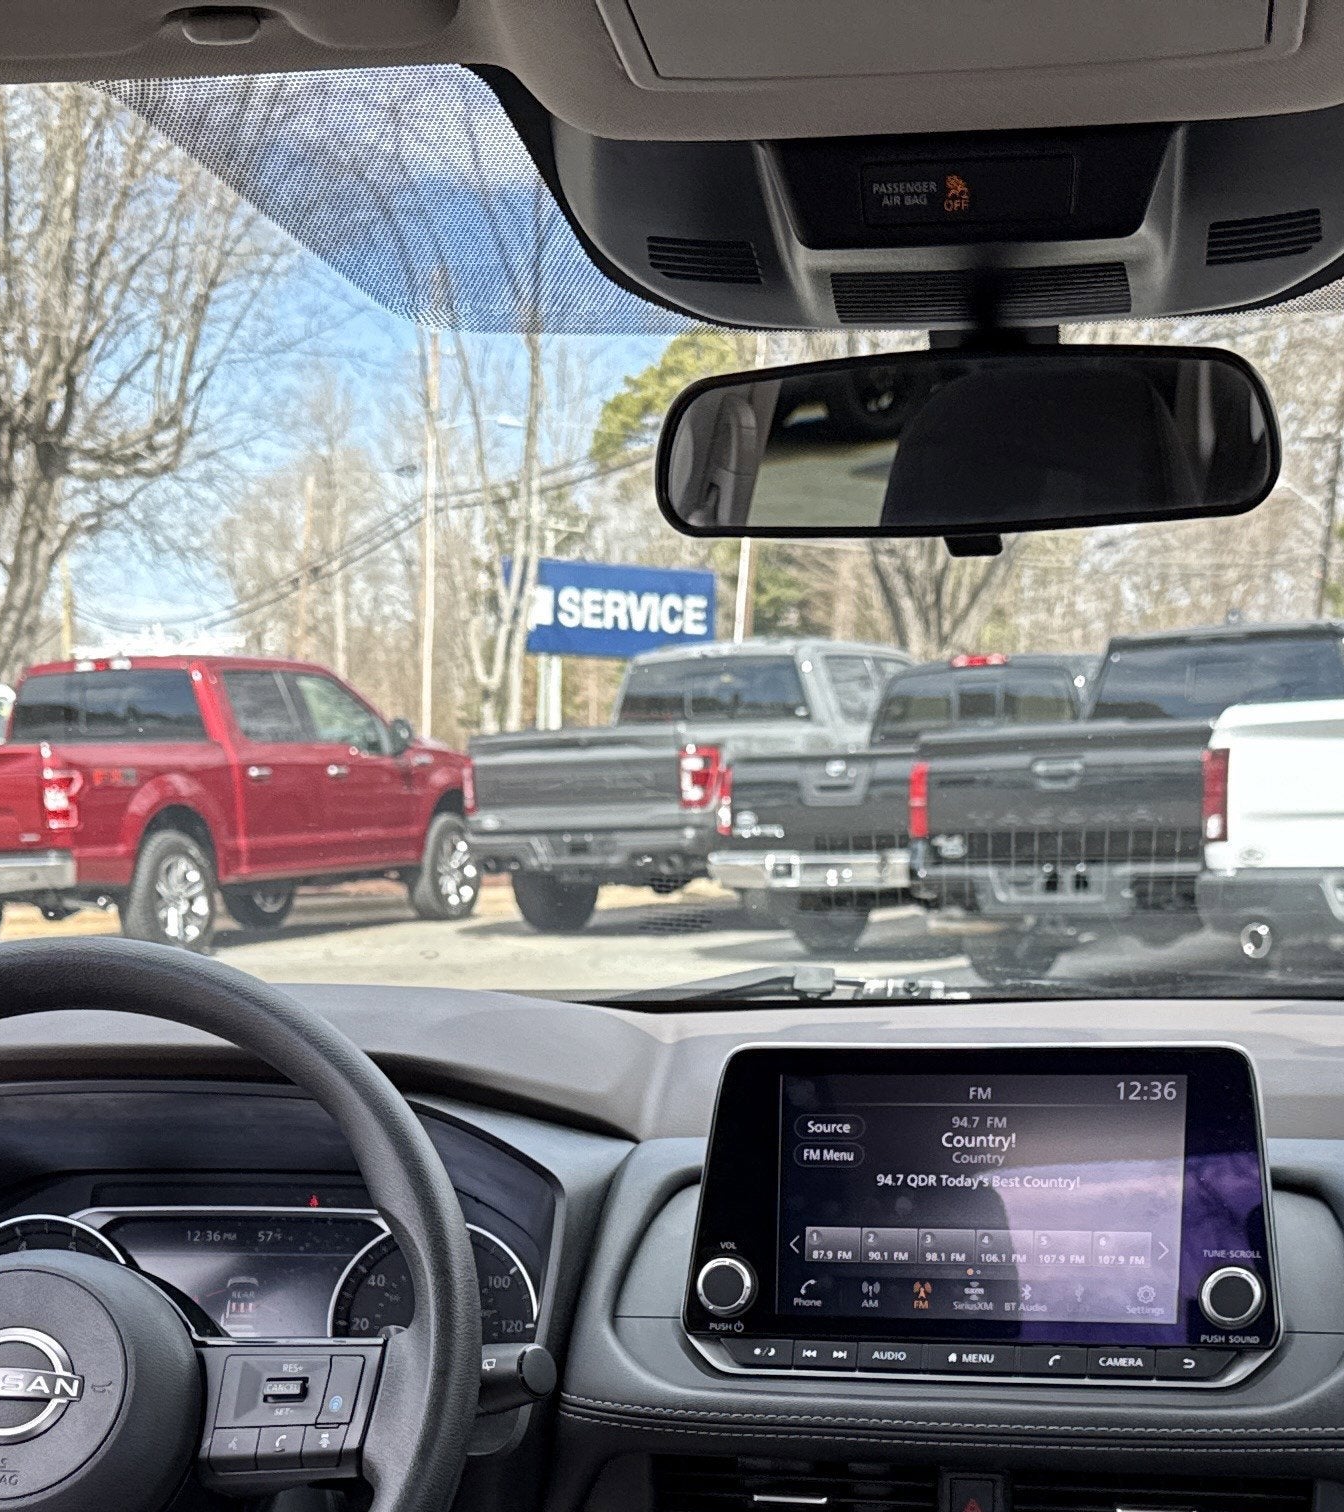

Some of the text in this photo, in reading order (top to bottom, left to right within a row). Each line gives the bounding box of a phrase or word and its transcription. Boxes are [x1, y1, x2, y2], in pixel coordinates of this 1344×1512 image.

[872, 181, 938, 195] PASSENGER
[881, 195, 901, 206] AIR
[943, 200, 970, 212] OFF
[557, 585, 709, 636] SERVICE
[968, 1087, 992, 1100] FM
[1116, 1081, 1178, 1101] 12:36
[807, 1120, 852, 1134] Source
[951, 1116, 1007, 1128] 94.7 FM
[941, 1132, 1017, 1150] Country!
[803, 1149, 855, 1161] FM Menu
[952, 1152, 1005, 1167] Country
[876, 1174, 1081, 1191] 94.7 QDR Today's Best Country!
[719, 1241, 737, 1250] VOL
[812, 1250, 853, 1260] 87.9 FM
[868, 1251, 909, 1261] 90.1 FM
[925, 1252, 966, 1262] 98.1 FM
[980, 1253, 1027, 1263] 106.1 FM
[1069, 1255, 1085, 1264] FM
[1129, 1256, 1145, 1265] FM
[367, 1273, 386, 1287] 40
[488, 1275, 511, 1289] 100
[793, 1297, 822, 1307] Phone
[861, 1299, 879, 1308] AM
[913, 1300, 929, 1309] FM
[952, 1302, 994, 1311] SiriusXM
[1004, 1302, 1048, 1312] BT Audio
[351, 1317, 370, 1331] 20
[500, 1319, 524, 1332] 120
[709, 1322, 733, 1331] PUSH
[1200, 1334, 1260, 1344] PUSH SOUND
[872, 1351, 907, 1361] AUDIO
[961, 1353, 995, 1364] MENU
[1098, 1356, 1144, 1368] CAMERA
[266, 1383, 301, 1393] CANCEL
